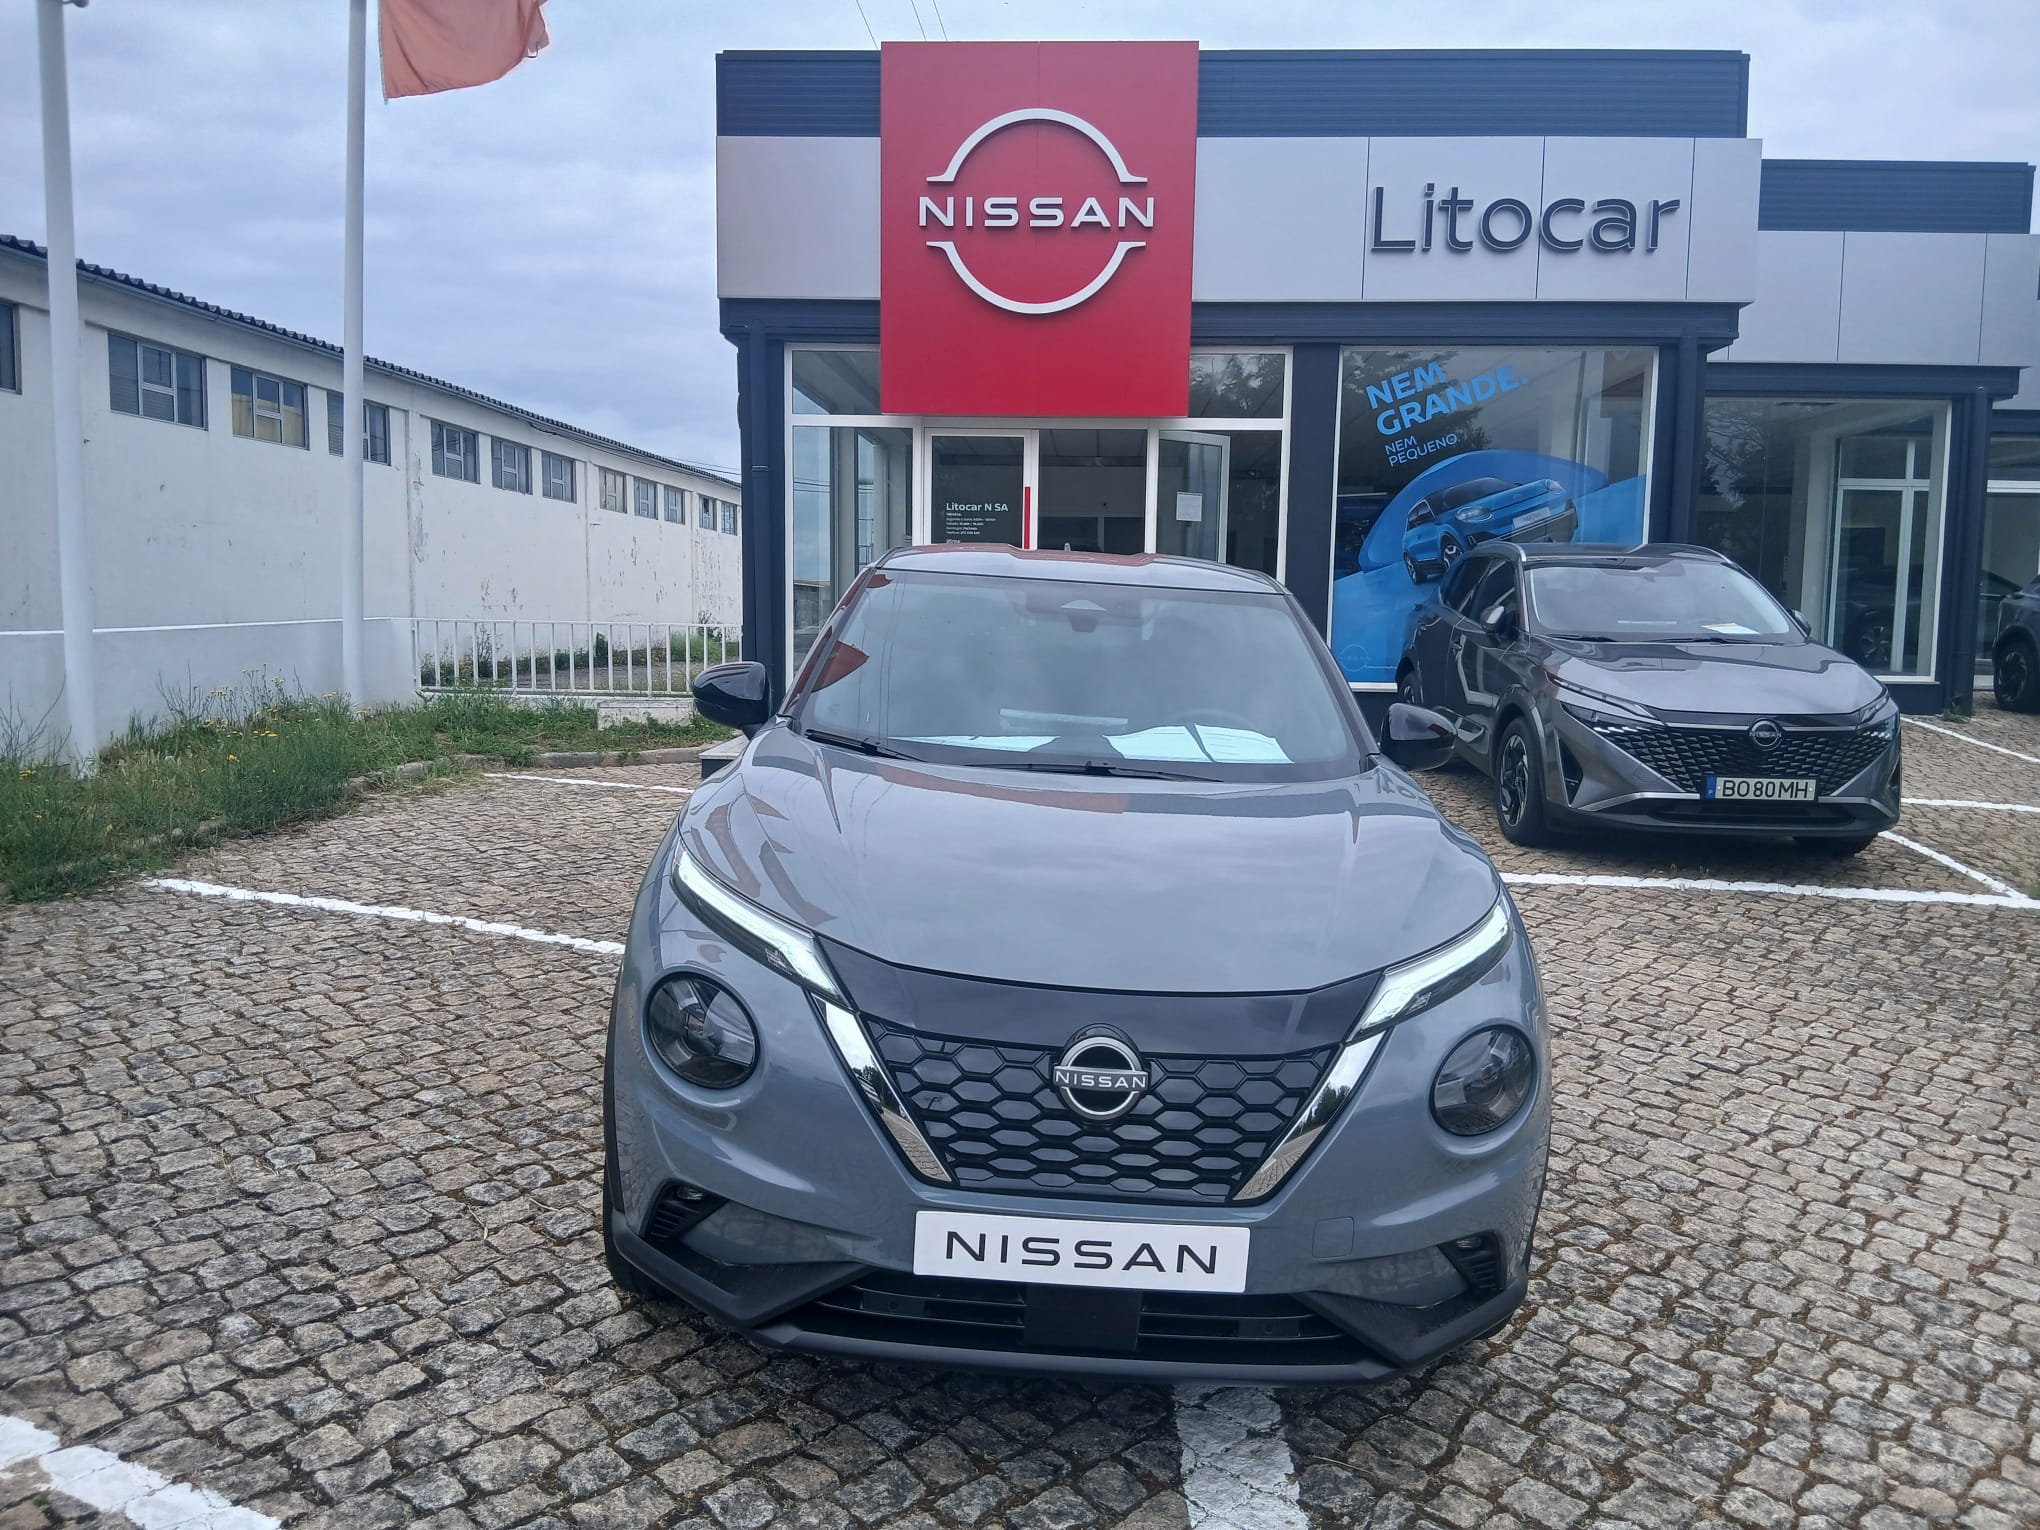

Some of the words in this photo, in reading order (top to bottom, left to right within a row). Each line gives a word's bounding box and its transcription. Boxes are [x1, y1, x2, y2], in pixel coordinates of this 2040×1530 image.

[918, 196, 1155, 228] NISSAN
[1371, 183, 1681, 252] Litocar
[1366, 361, 1446, 410] NEM
[1376, 364, 1528, 436] GRANDE.
[1385, 435, 1418, 455] NEM
[1388, 433, 1461, 468] PEQUENO.
[946, 502, 982, 511] Litocar
[984, 503, 992, 511] N
[994, 503, 1009, 512] SA
[1055, 1070, 1146, 1089] NISSAN
[946, 1230, 1218, 1275] NISSAN
